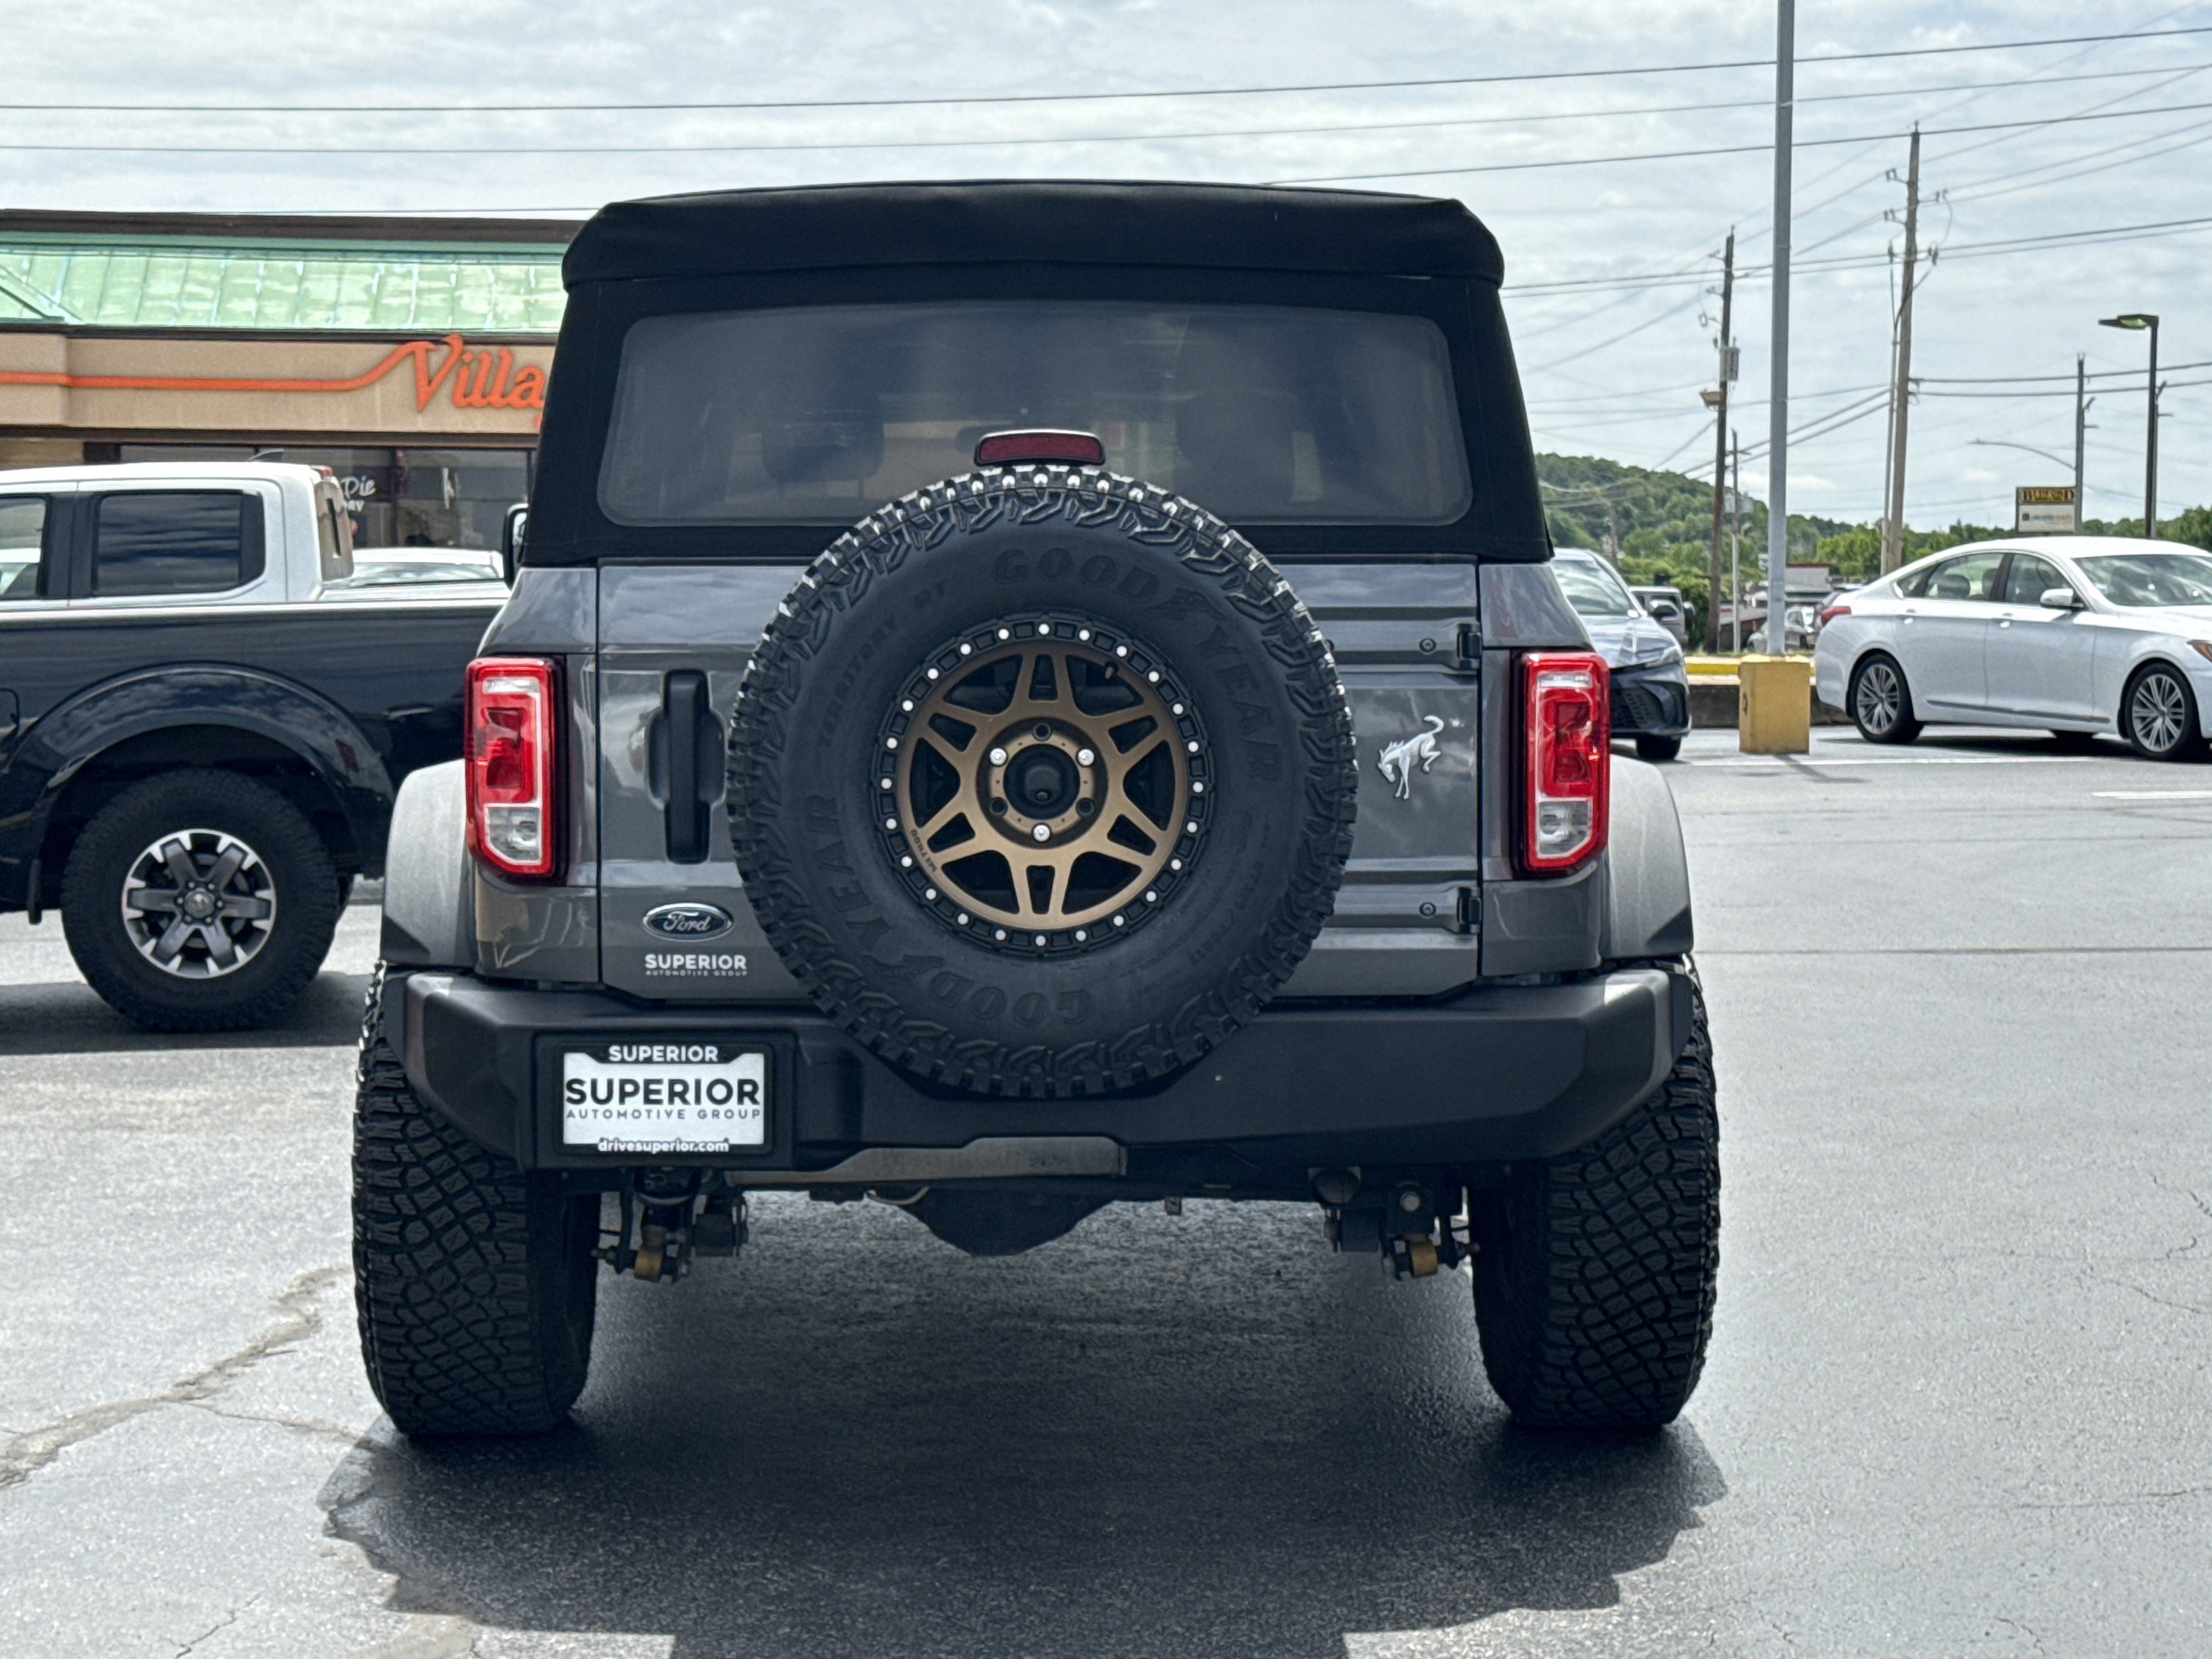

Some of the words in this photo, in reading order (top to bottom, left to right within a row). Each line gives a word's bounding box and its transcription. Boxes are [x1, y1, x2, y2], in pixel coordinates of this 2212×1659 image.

[405, 331, 545, 431] Villa
[662, 911, 712, 932] Ford
[645, 953, 747, 970] SUPERIOR
[608, 1045, 718, 1063] SUPERIOR
[566, 1078, 760, 1106] SUPERIOR
[566, 1109, 686, 1120] AUTOMOTIVE
[697, 1109, 760, 1120] GROUP
[597, 1137, 730, 1154] drivesuperior.com
